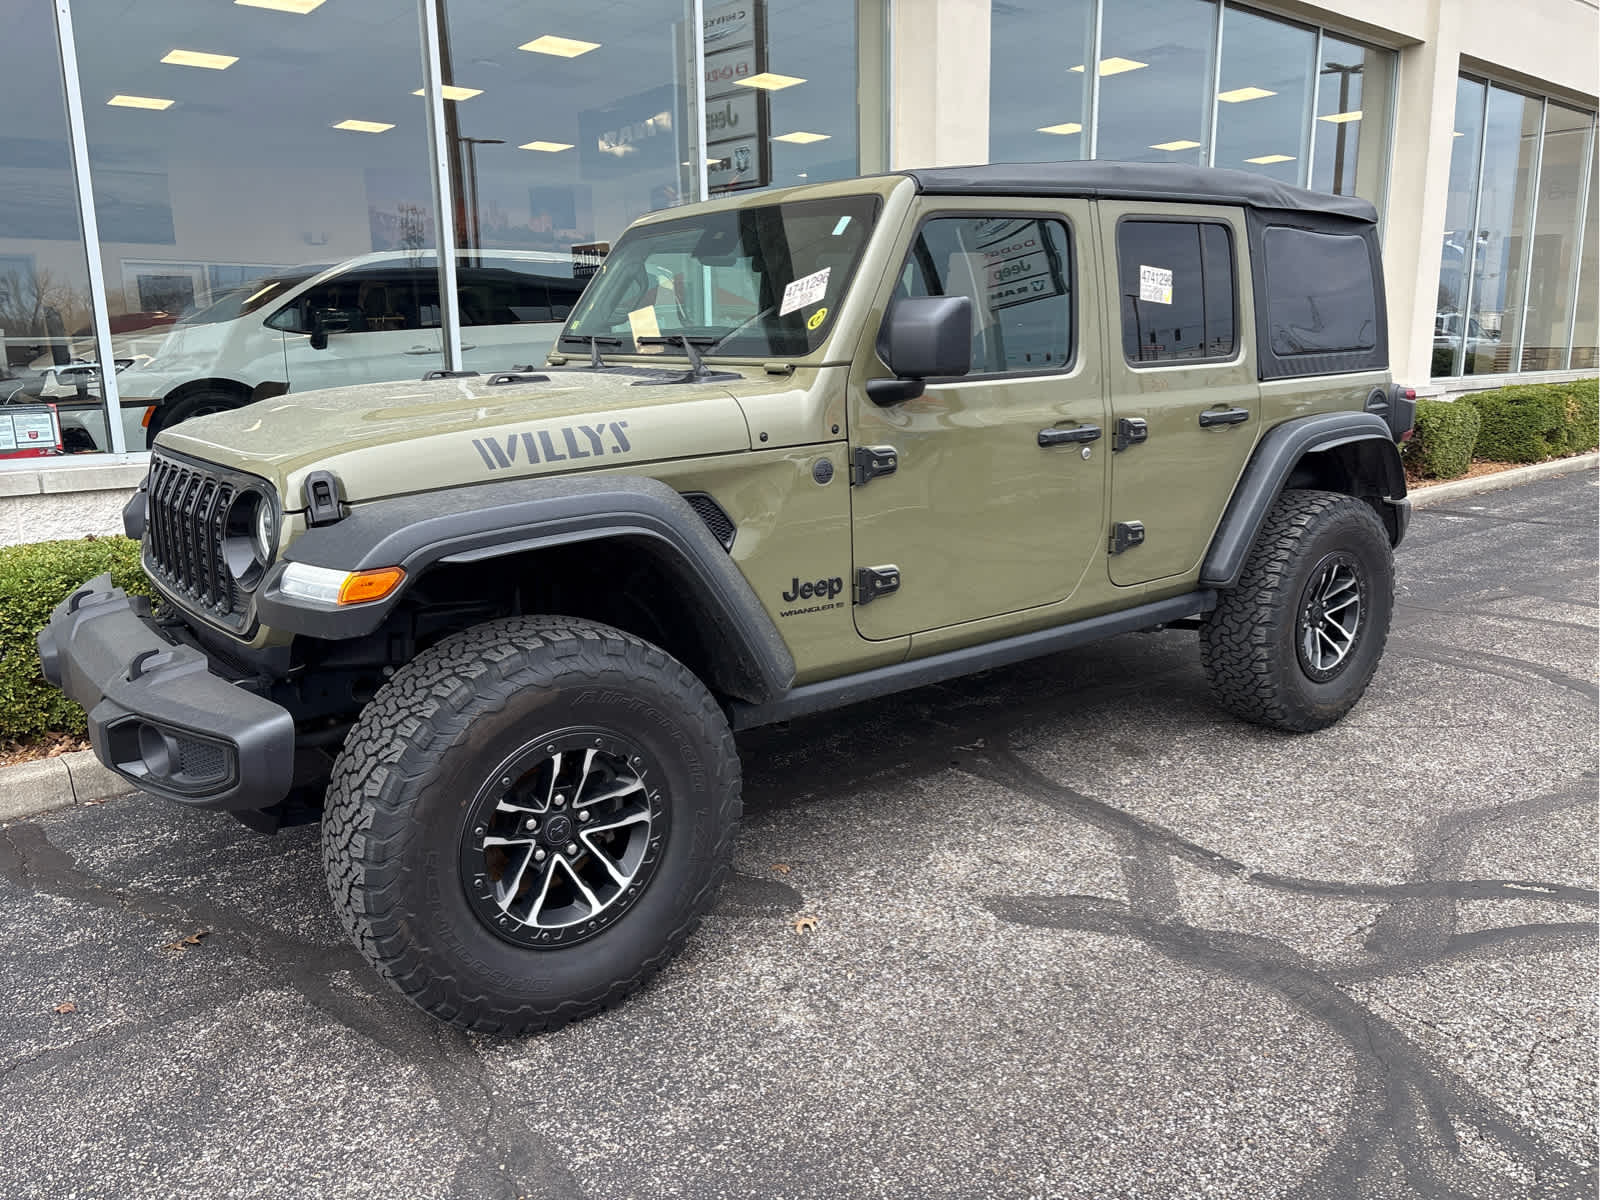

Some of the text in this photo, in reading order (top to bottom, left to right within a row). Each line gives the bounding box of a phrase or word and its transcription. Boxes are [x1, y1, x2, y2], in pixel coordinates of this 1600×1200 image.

[471, 420, 632, 471] WILLYS
[782, 576, 843, 602] Jeep
[779, 602, 834, 617] WRANGLER
